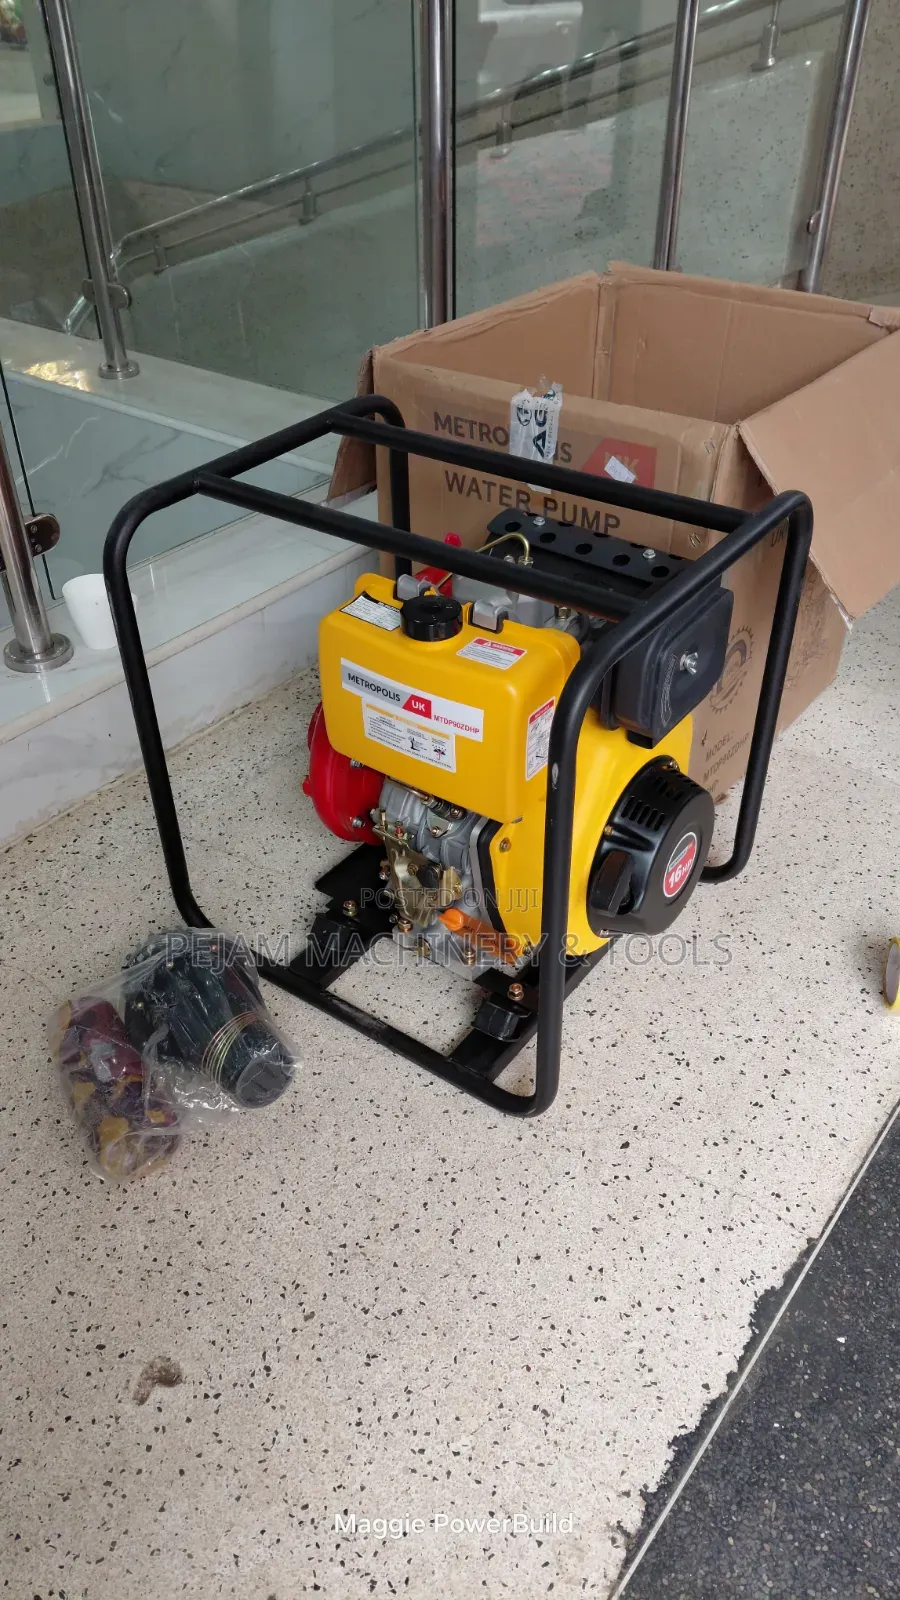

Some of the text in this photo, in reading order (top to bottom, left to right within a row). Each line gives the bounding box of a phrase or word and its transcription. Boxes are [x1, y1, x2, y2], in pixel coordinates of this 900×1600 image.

[434, 411, 573, 464] METROIS
[444, 470, 621, 535] WATER PUMP
[347, 672, 426, 712] METROPOLIS UK
